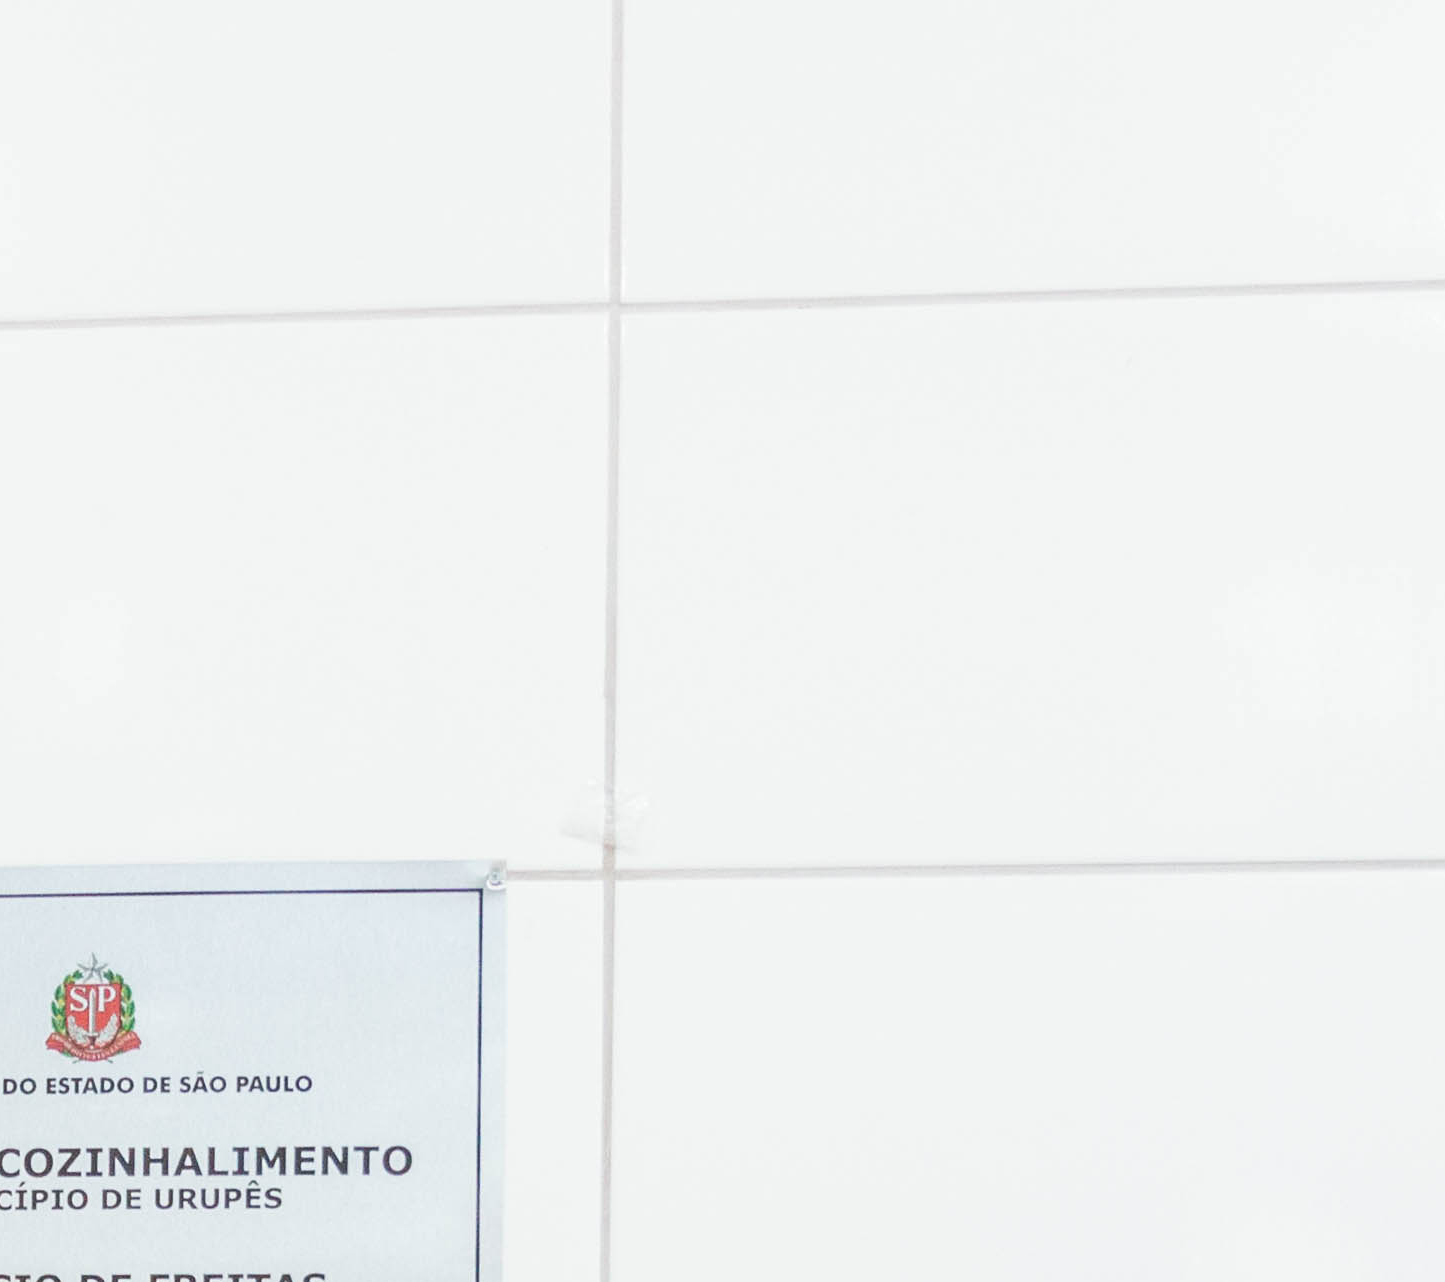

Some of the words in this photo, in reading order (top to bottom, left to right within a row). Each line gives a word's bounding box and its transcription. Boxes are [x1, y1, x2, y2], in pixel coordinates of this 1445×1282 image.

[2, 1076, 38, 1096] DO
[45, 1076, 135, 1096] ESTADO
[142, 1075, 172, 1094] DE
[179, 1070, 228, 1094] SÃO
[235, 1074, 314, 1094] PAULO
[101, 1188, 142, 1211] DE
[154, 1179, 283, 1211] URUPÊS
